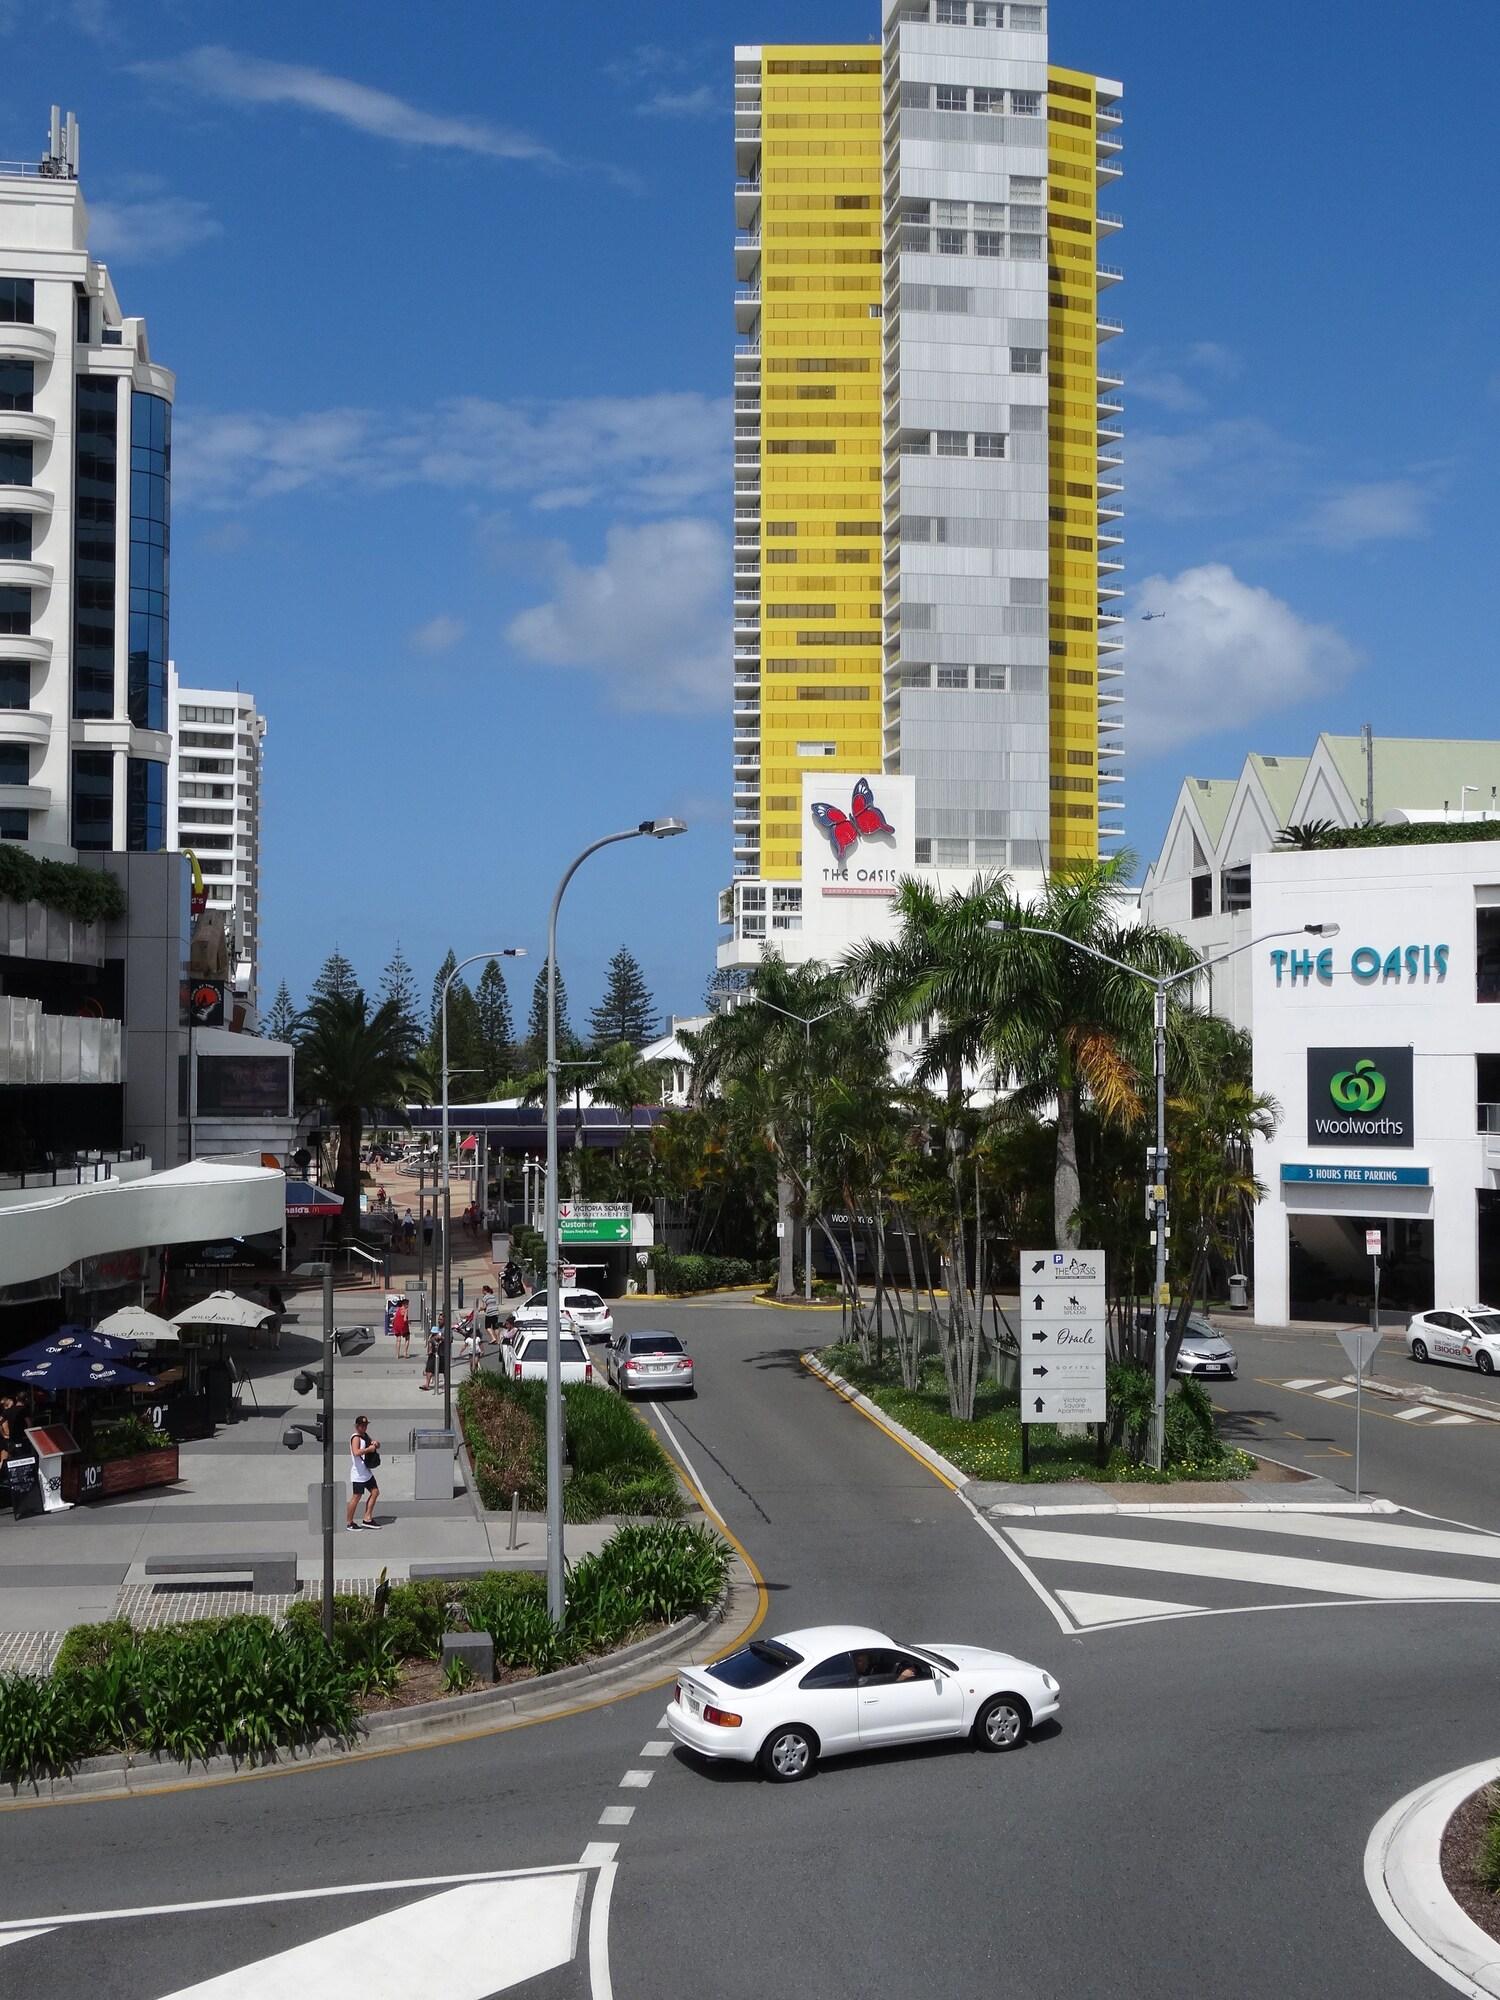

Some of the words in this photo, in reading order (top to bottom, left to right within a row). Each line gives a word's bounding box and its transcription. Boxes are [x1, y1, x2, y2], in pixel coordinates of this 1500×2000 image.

[822, 868, 849, 881] THE
[856, 869, 896, 881] OASIS
[1270, 947, 1333, 979] THE
[1351, 944, 1450, 978] OASIS
[1308, 1169, 1314, 1179] 3
[1316, 1169, 1341, 1180] HOURS
[1344, 1170, 1362, 1180] FREE
[1364, 1170, 1398, 1181] PARKING
[1071, 1267, 1096, 1275] OASIS
[1056, 1328, 1095, 1345] Oracle
[1434, 1345, 1461, 1355] 131008
